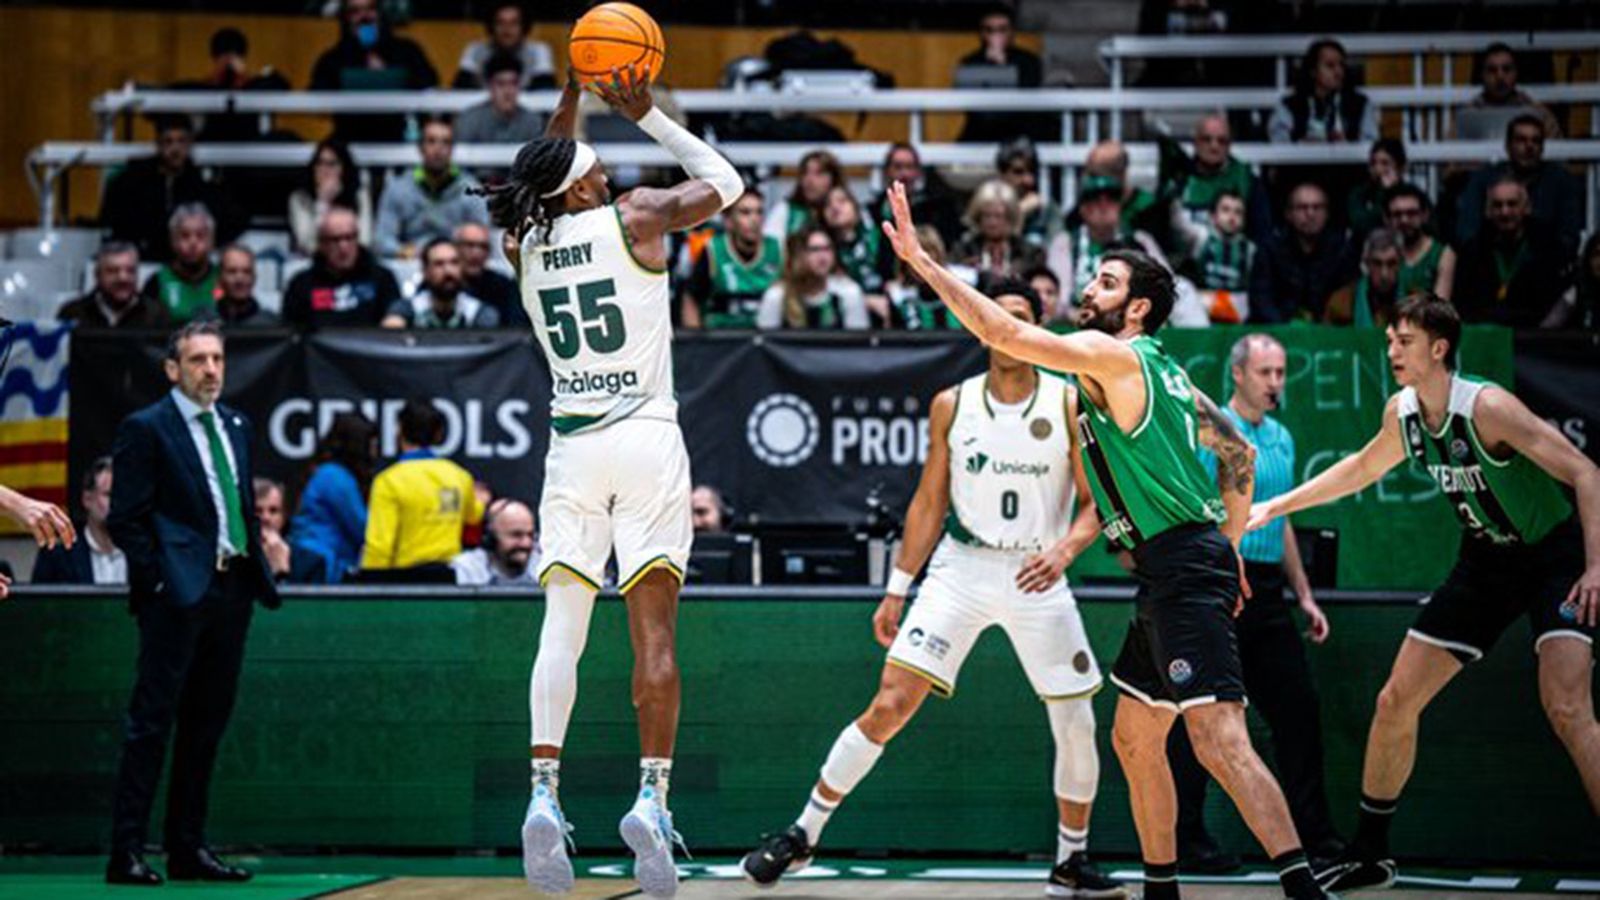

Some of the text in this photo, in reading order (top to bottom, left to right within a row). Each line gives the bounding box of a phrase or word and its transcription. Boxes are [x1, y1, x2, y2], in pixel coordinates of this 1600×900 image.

[541, 242, 593, 272] PERRY
[537, 277, 627, 361] 55
[992, 460, 1050, 478] Unicaja
[1001, 489, 1019, 521] 0
